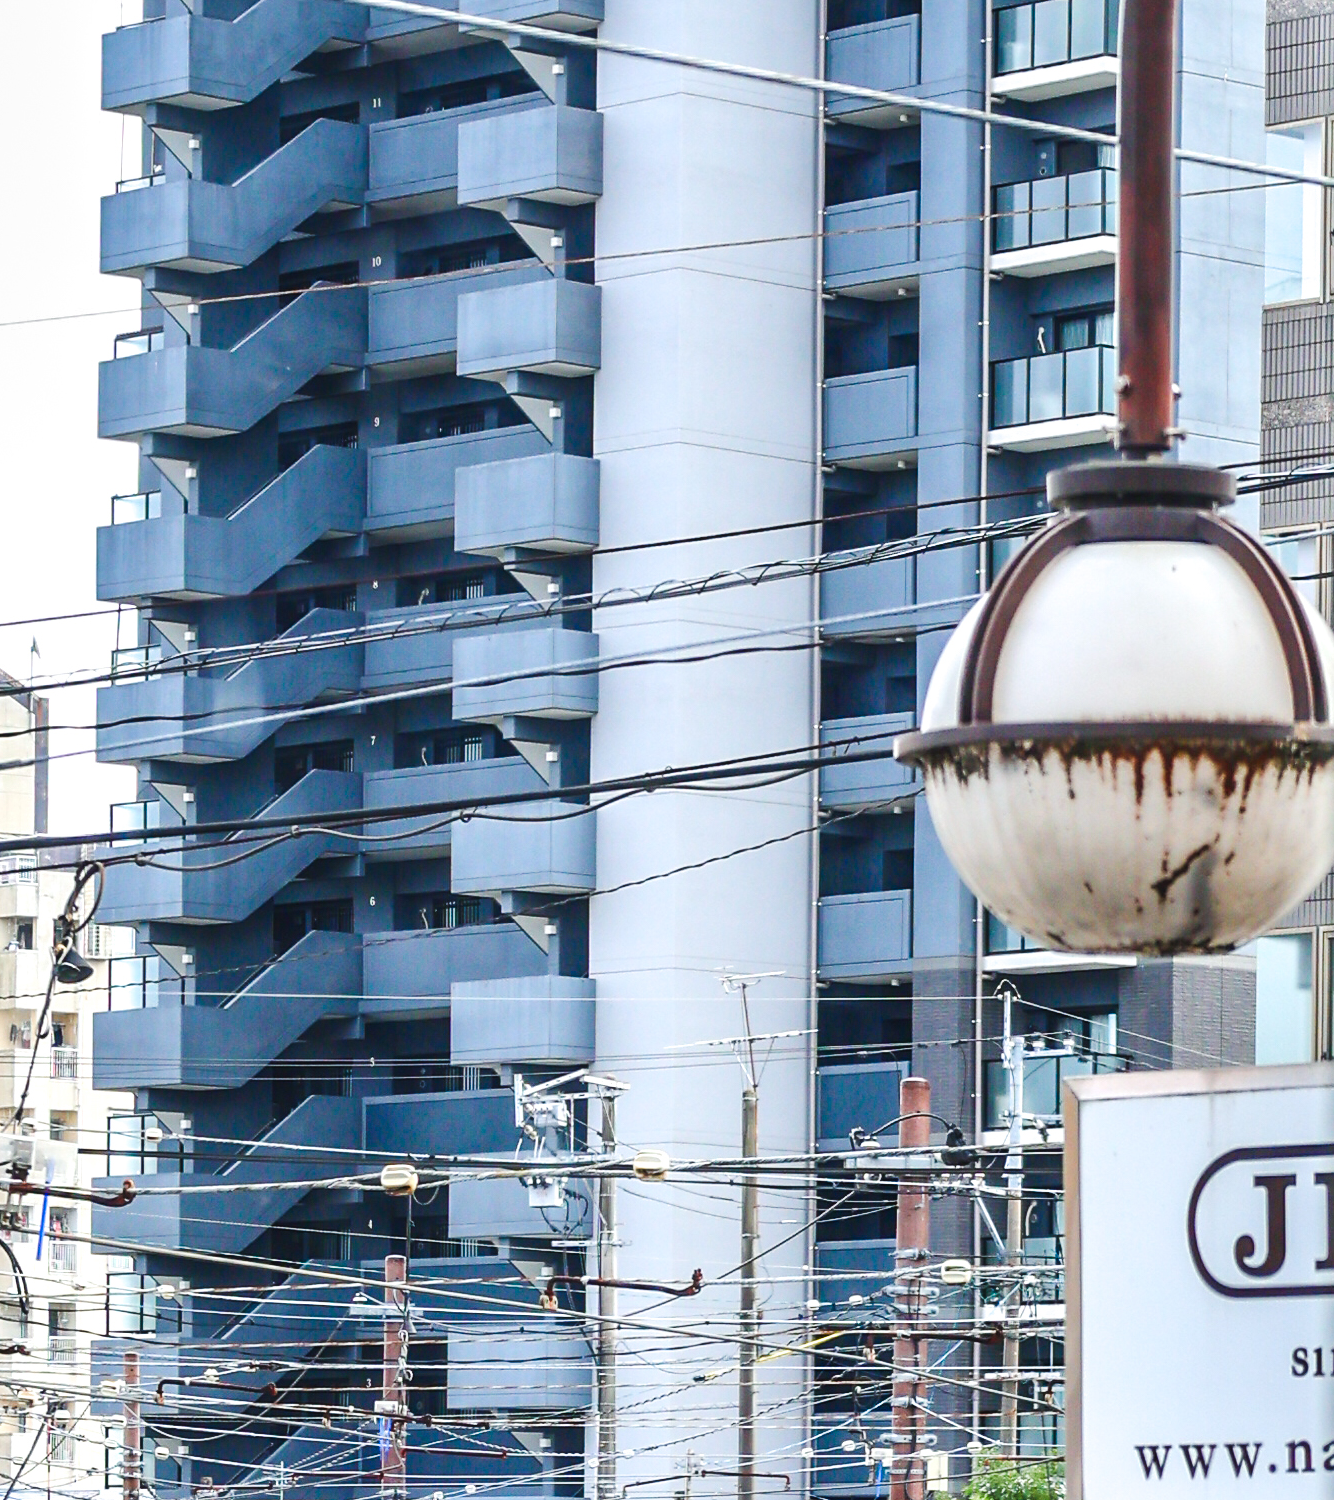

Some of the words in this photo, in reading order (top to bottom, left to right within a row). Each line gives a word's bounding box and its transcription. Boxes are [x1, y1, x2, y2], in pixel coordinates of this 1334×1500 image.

[371, 255, 382, 268] 10
[373, 416, 380, 427] 9
[370, 735, 376, 746] 7
[369, 896, 376, 907] 6
[365, 1378, 372, 1389] 3
